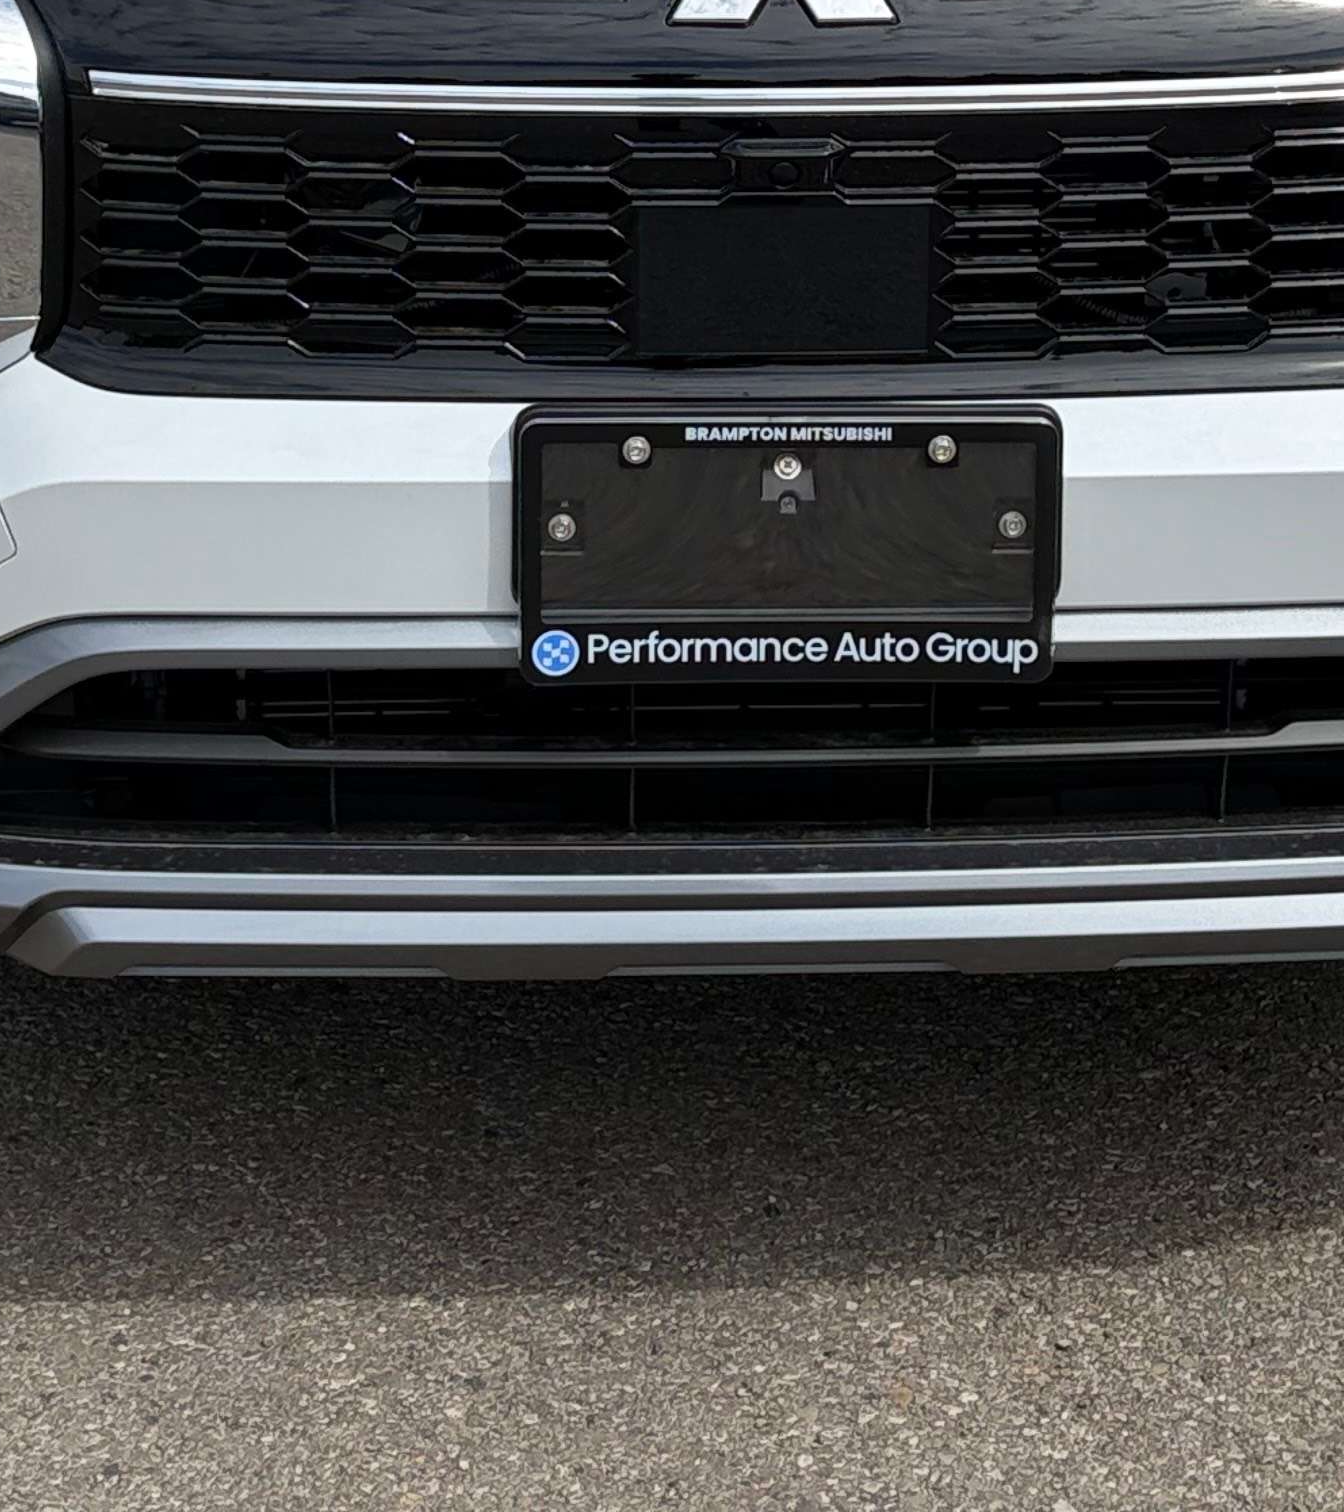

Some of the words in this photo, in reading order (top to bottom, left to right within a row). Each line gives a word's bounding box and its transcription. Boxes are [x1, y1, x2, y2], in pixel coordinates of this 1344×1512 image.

[685, 426, 788, 441] BRAMPTON
[790, 426, 893, 441] MITSUBISHI
[587, 630, 829, 664] Performance
[833, 631, 920, 663] Auto
[925, 631, 1039, 674] Group
